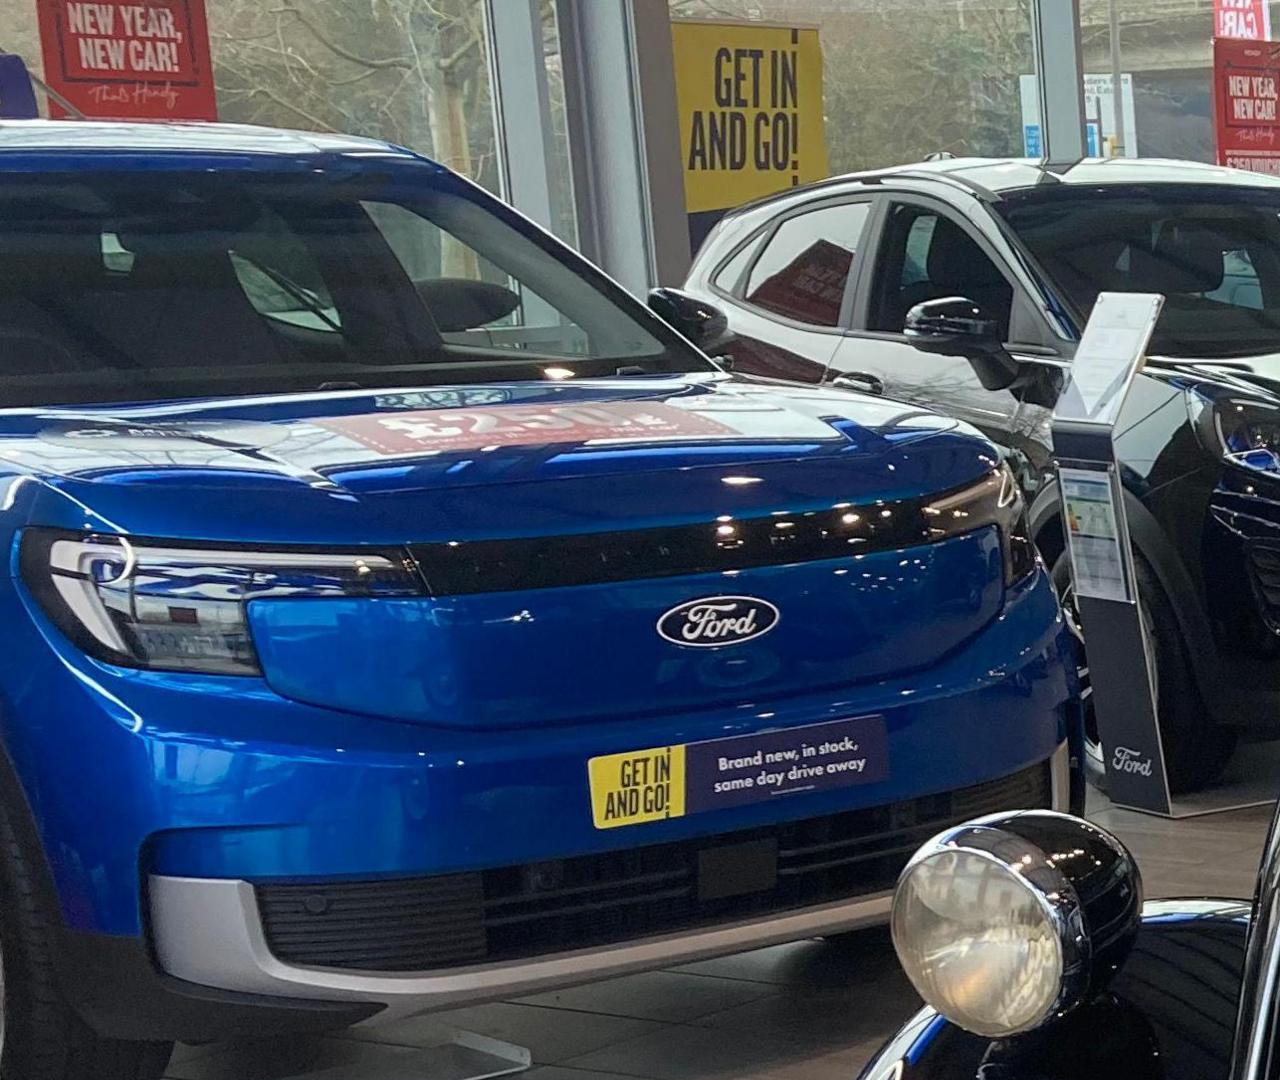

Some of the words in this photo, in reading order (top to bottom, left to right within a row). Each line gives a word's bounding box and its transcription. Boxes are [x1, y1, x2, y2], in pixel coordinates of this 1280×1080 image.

[67, 2, 114, 36] NEW
[118, 4, 182, 43] YEAR,
[78, 38, 125, 70] NEW
[129, 40, 179, 72] CAR!
[714, 47, 764, 108] GET
[771, 50, 798, 108] IN
[1229, 76, 1253, 97] NEW
[1252, 77, 1278, 100] YEAR,
[1233, 98, 1255, 119] NEW
[1255, 99, 1276, 121] CAR!
[688, 110, 746, 170] AND
[754, 111, 799, 170] GO!
[681, 603, 757, 640] Ford
[621, 759, 649, 788] GET
[653, 754, 671, 782] IN
[718, 750, 763, 771] Brand
[765, 749, 800, 763] new,
[801, 743, 817, 757] in
[819, 736, 859, 755] stock,
[1112, 746, 1152, 776] Ford
[714, 777, 754, 793] same
[756, 771, 785, 786] day
[788, 765, 824, 780] drive
[826, 758, 866, 773] away
[604, 790, 638, 820] AND
[643, 783, 670, 810] GO!
